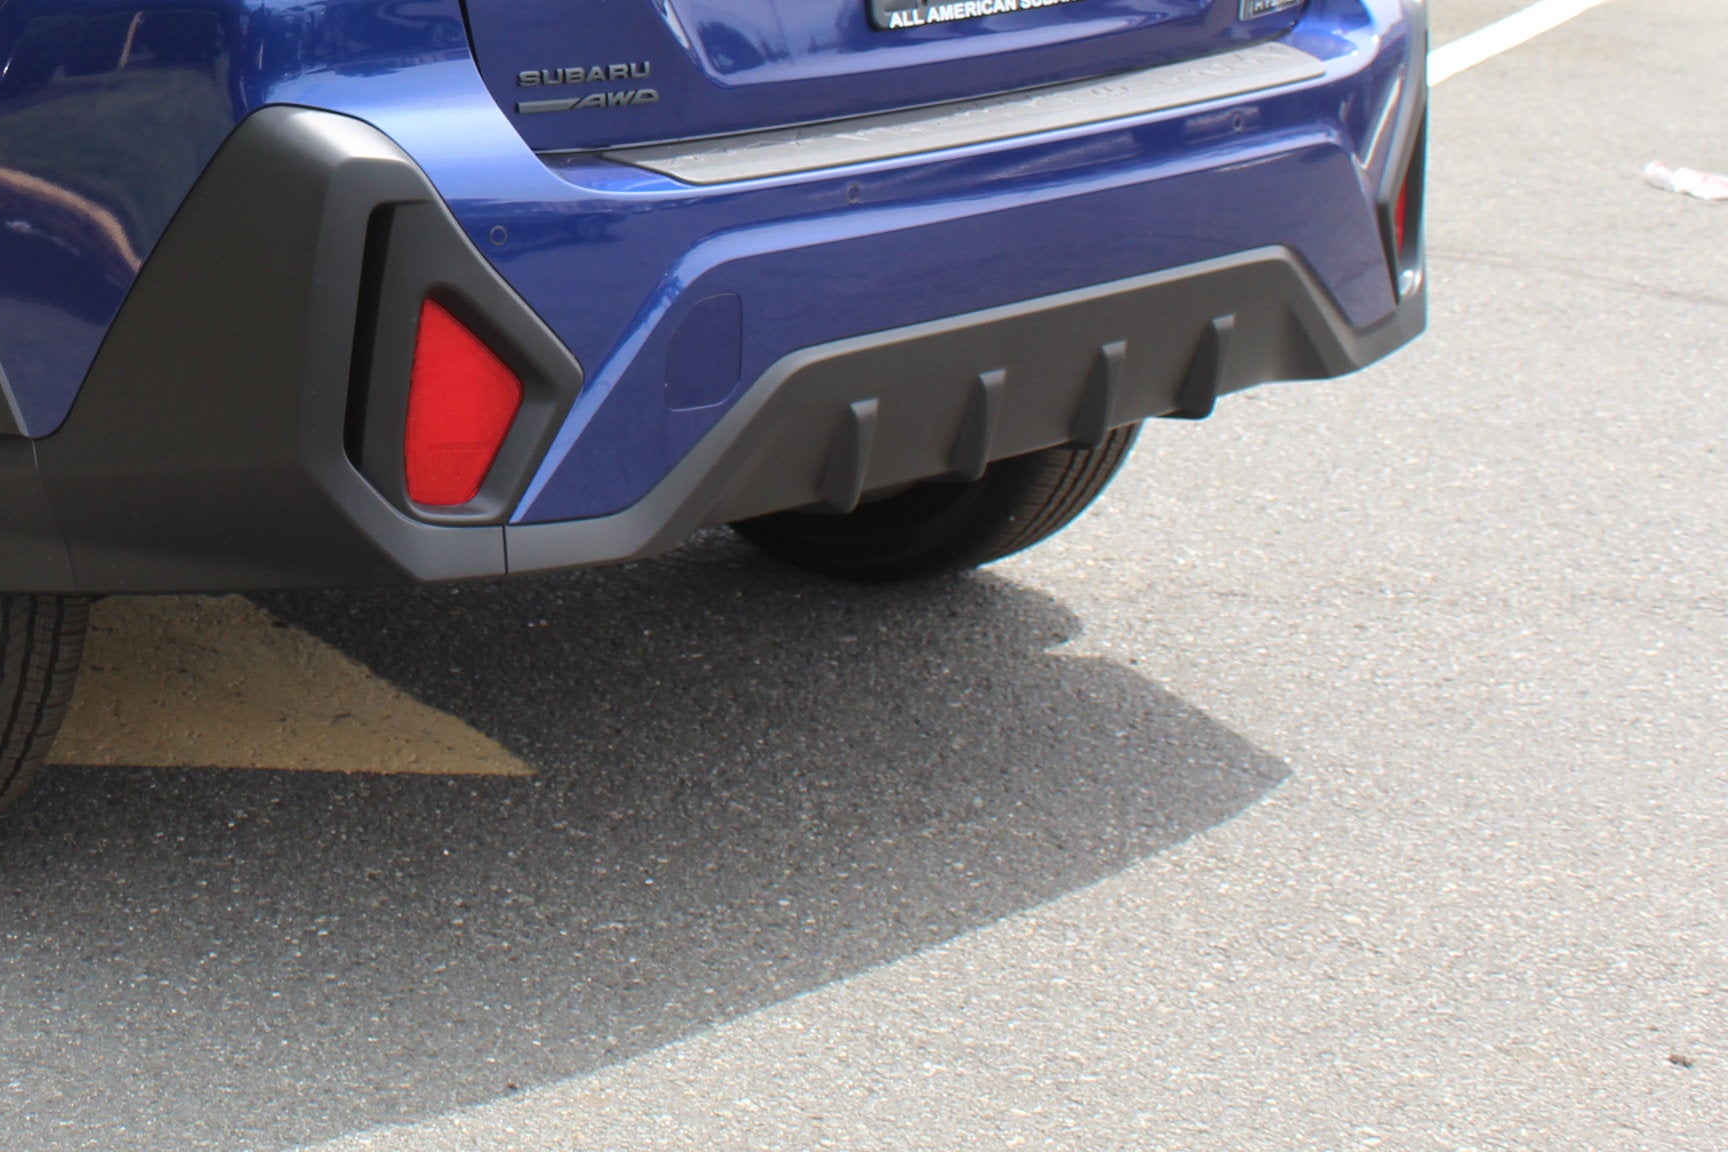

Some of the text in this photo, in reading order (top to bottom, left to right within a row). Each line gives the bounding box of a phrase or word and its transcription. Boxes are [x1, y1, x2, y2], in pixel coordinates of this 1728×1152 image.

[888, 8, 925, 29] ALL
[517, 61, 651, 87] SUBARU
[571, 88, 661, 110] AWD
